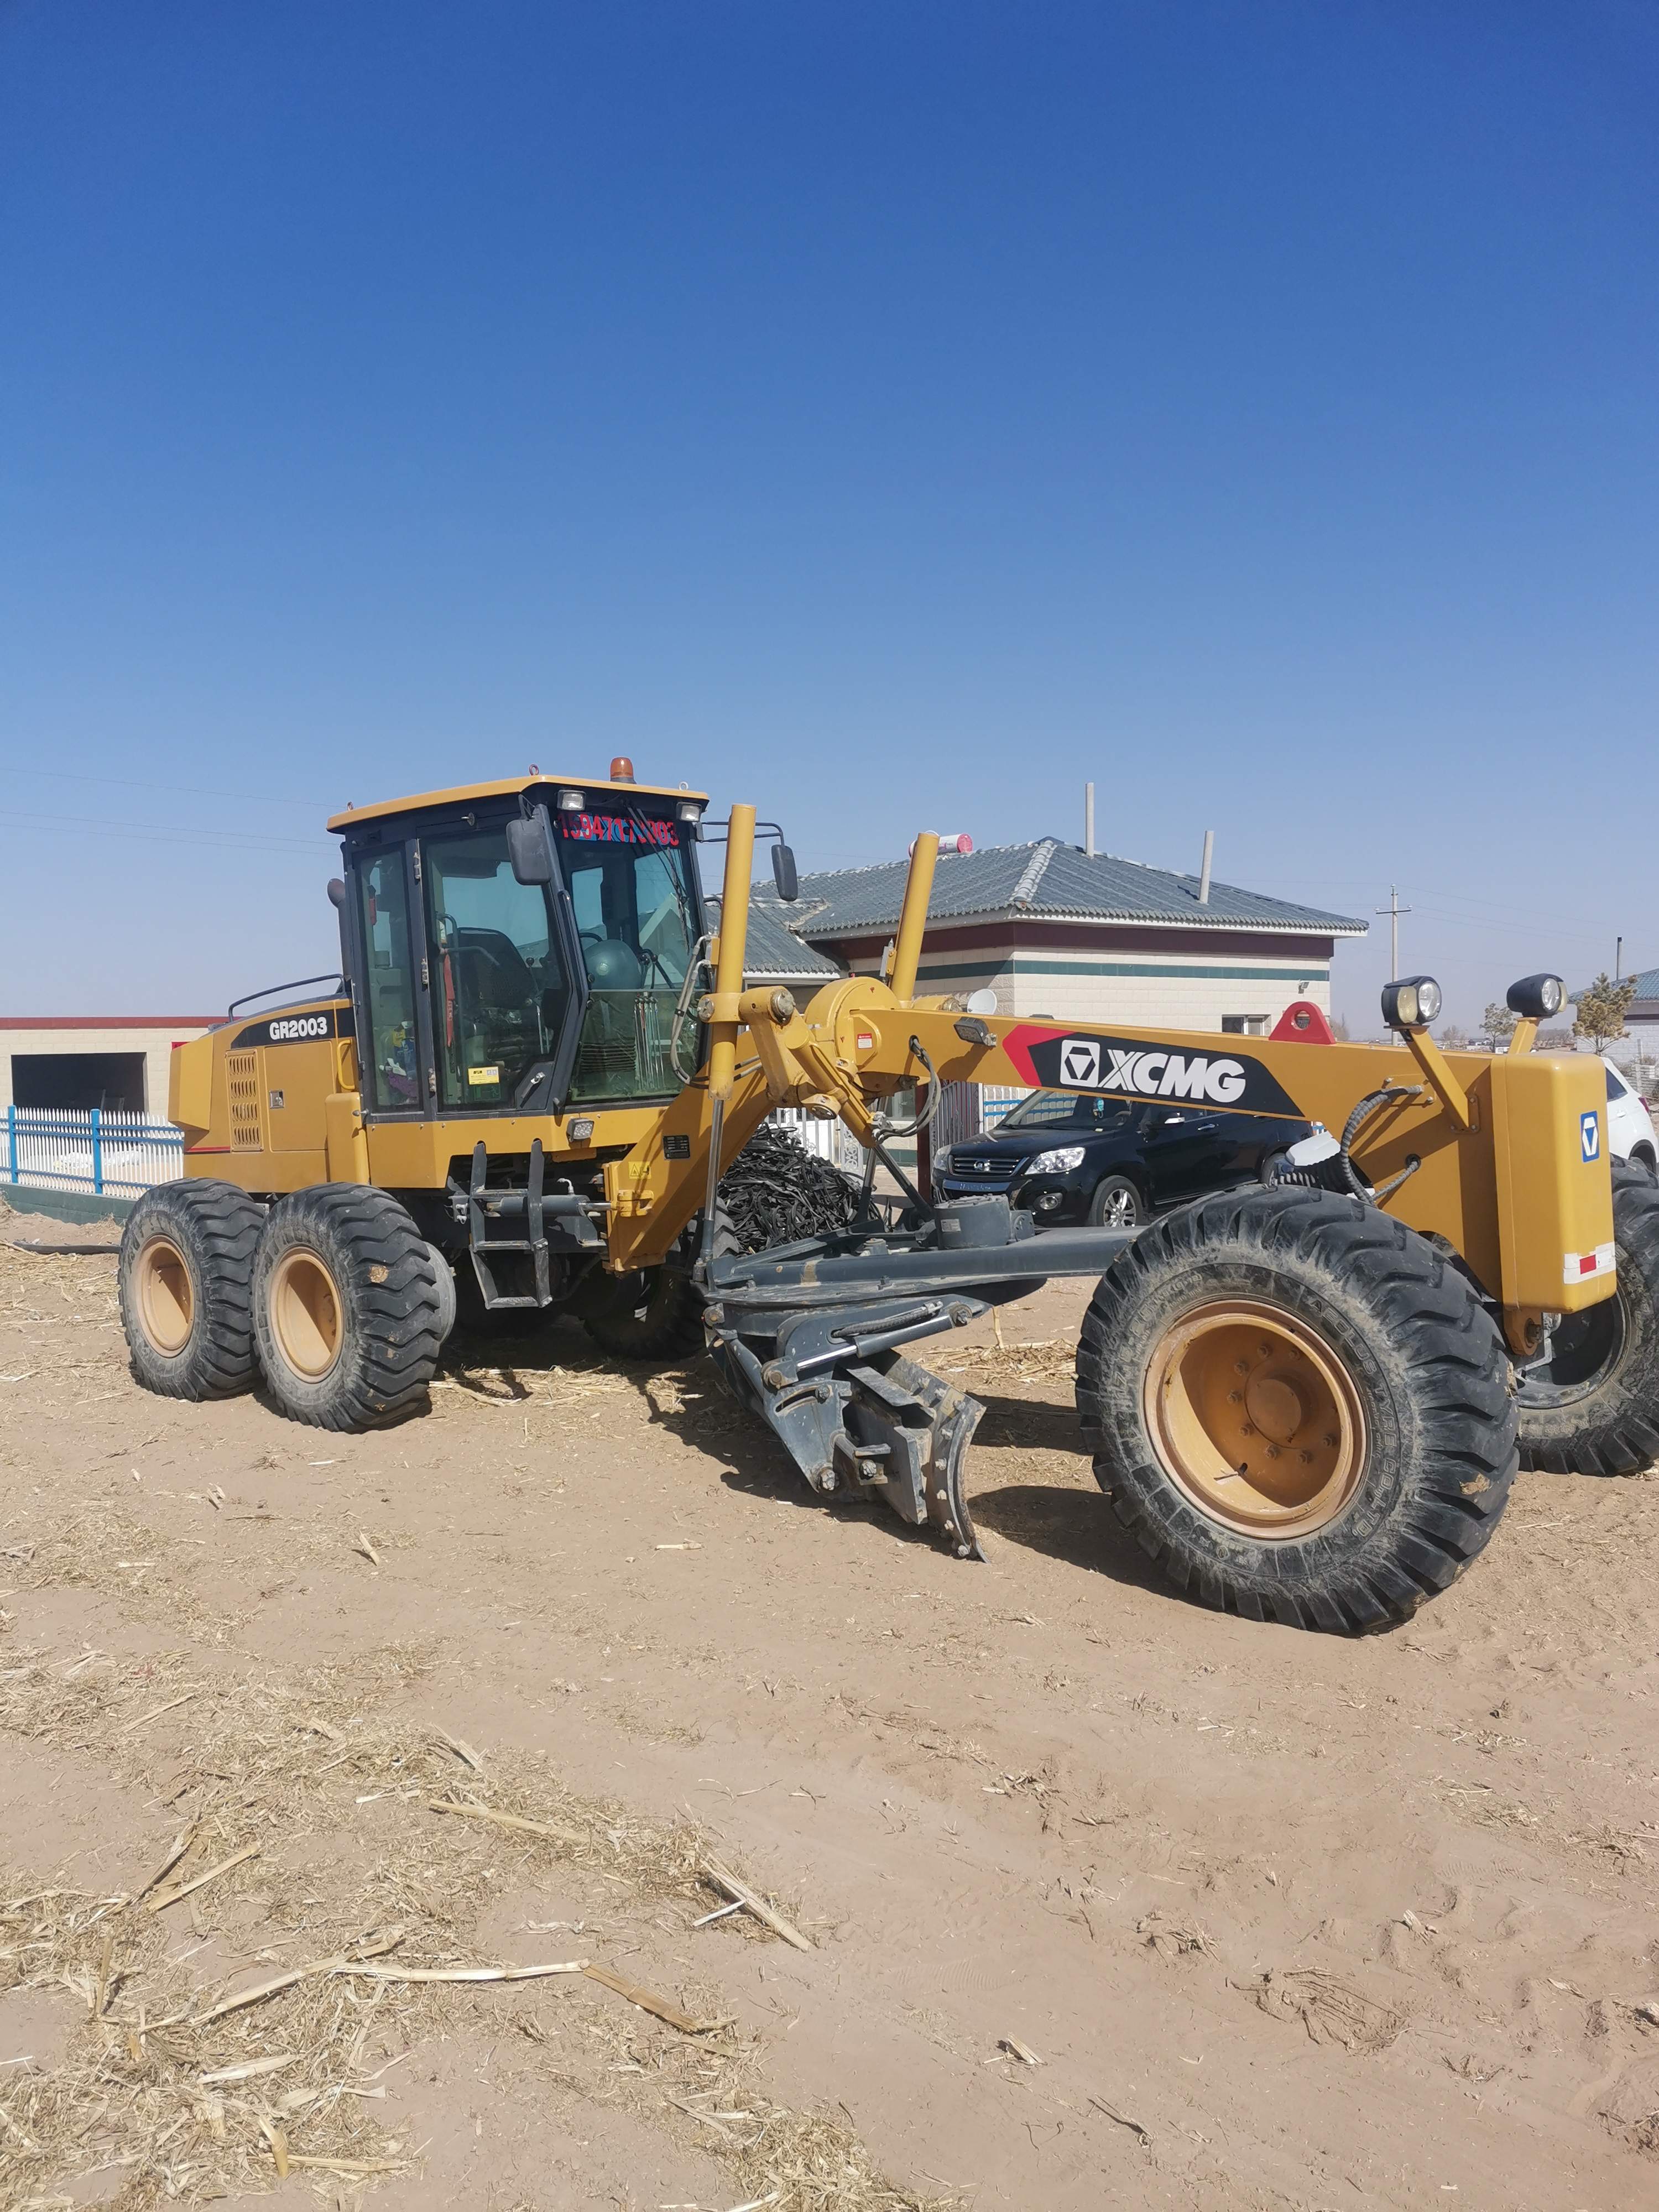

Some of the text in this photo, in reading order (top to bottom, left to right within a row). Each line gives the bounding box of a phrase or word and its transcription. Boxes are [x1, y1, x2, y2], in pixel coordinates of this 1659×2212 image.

[269, 1016, 327, 1040] GR2003
[1097, 1049, 1246, 1103] XCMG
[1307, 1299, 1378, 1374] AEOLUS
[1375, 1383, 1397, 1447] TYRE
